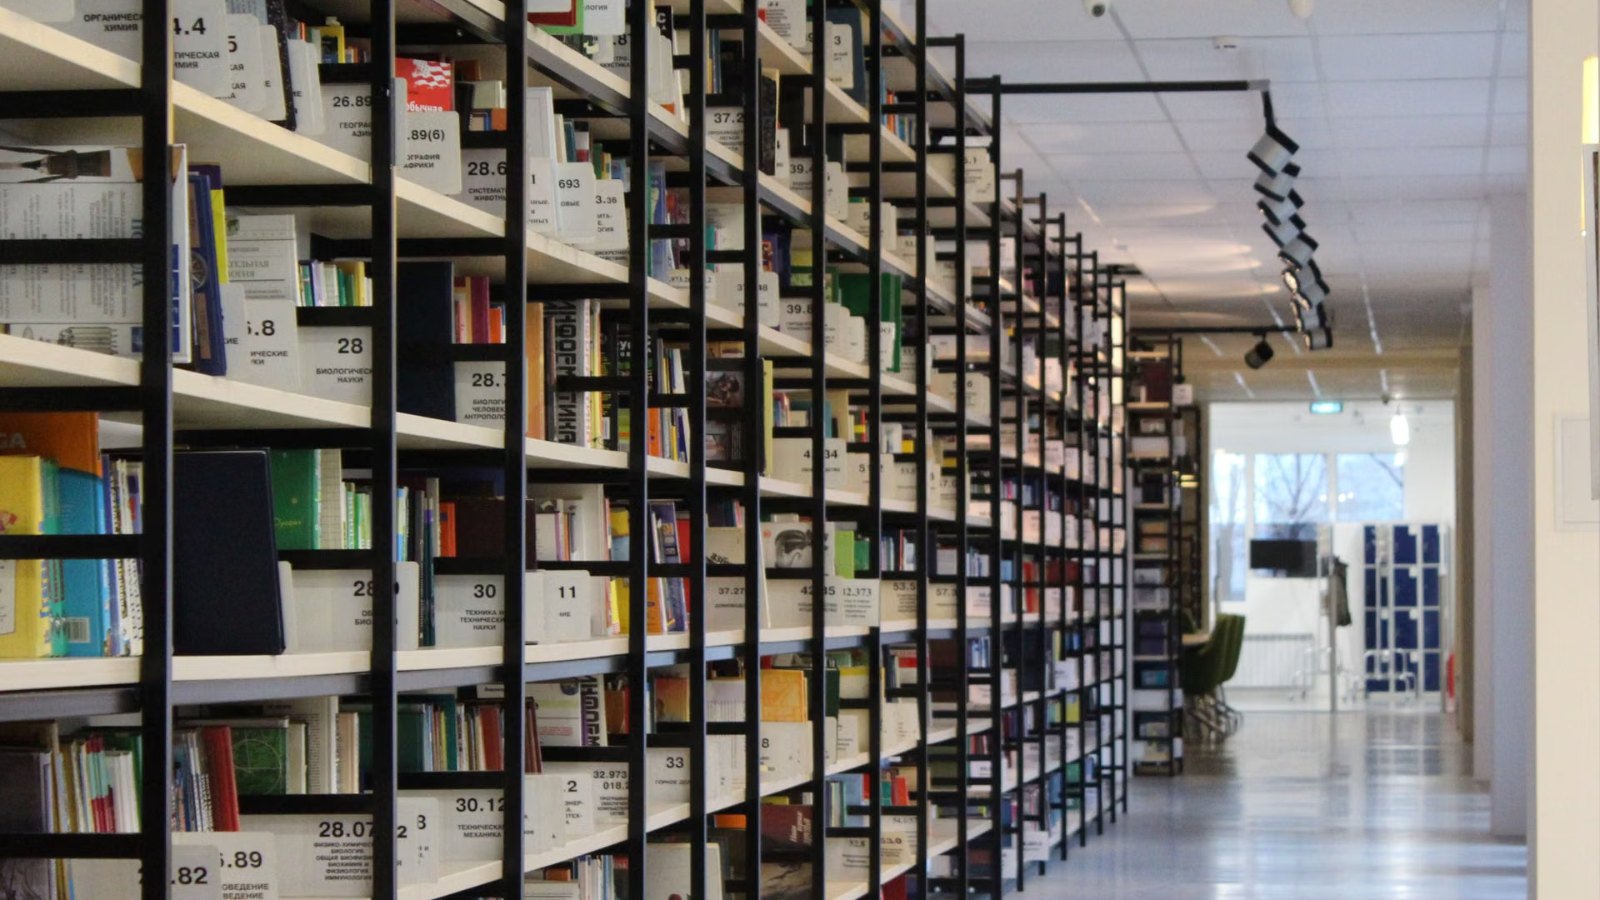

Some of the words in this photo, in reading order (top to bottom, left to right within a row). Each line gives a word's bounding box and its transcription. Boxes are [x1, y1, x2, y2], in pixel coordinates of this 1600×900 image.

[104, 23, 139, 32] ХИМИЯ
[406, 129, 446, 142] .89(6)
[467, 161, 507, 176] 28.6
[337, 337, 364, 355] 28
[555, 300, 578, 444] ИНФОРМТИКА
[337, 376, 364, 384] НАУКИ
[473, 583, 497, 599] 30
[666, 756, 685, 769] 33
[592, 770, 629, 780] 32.973
